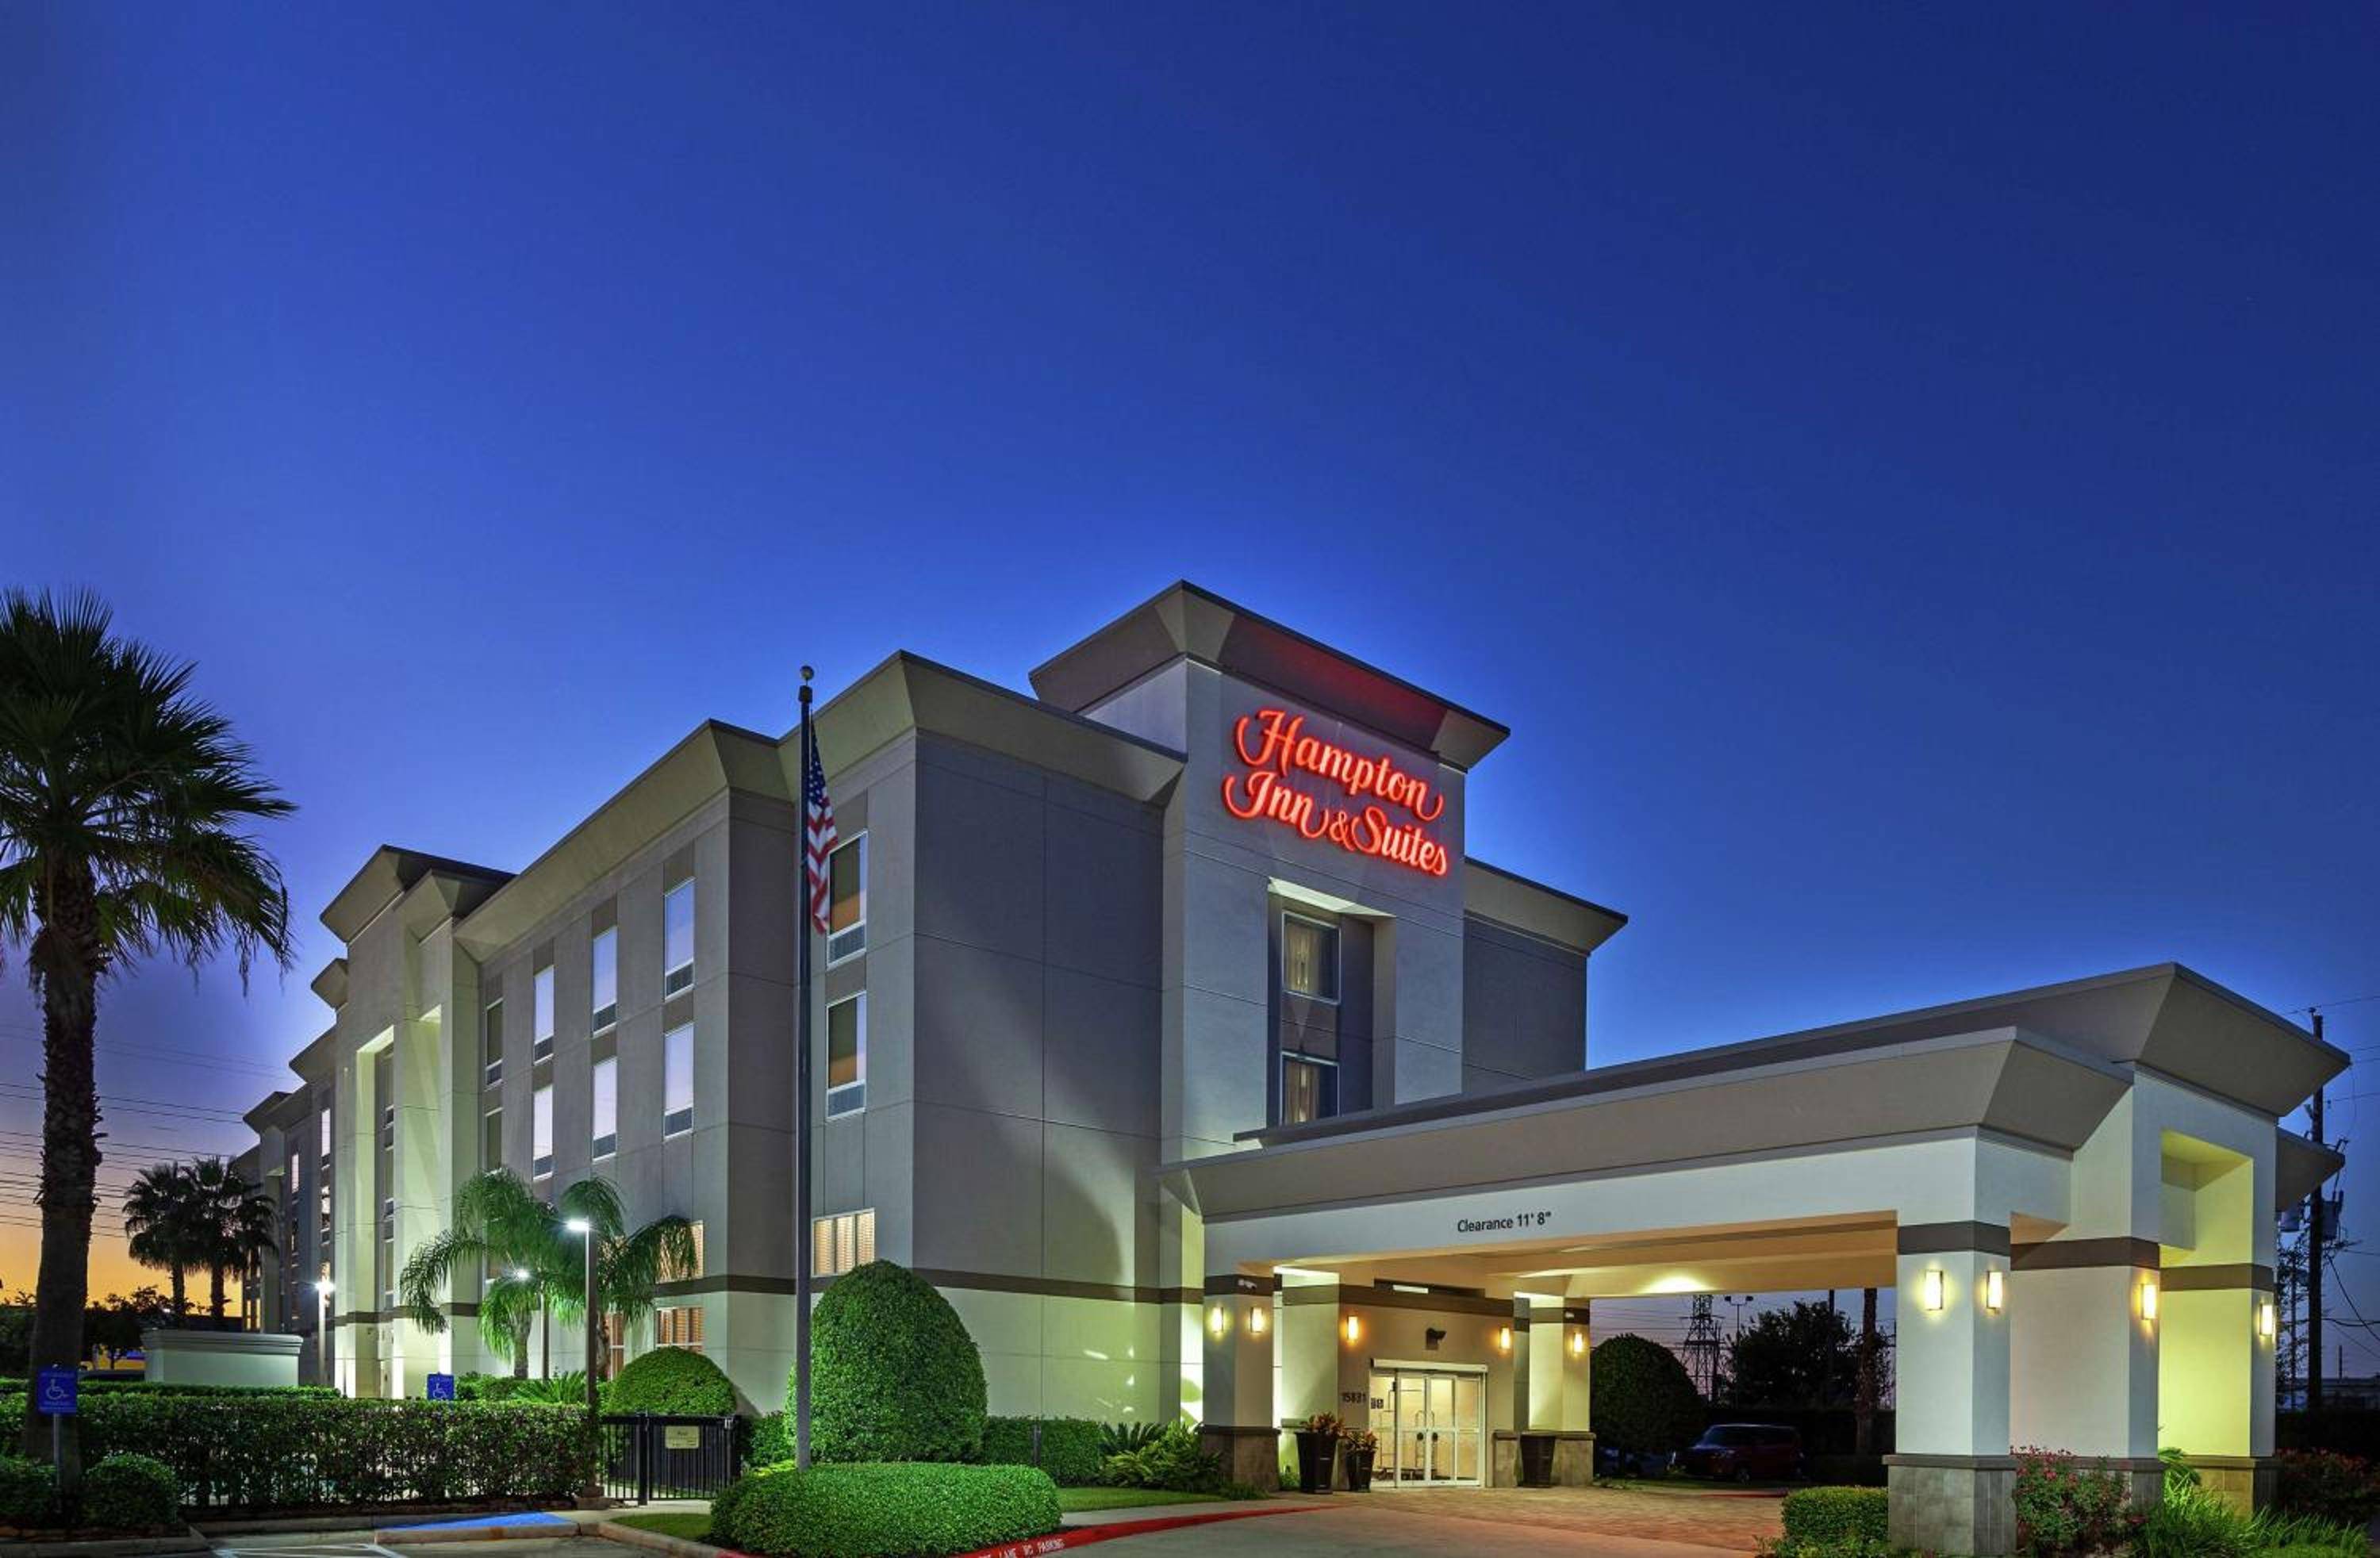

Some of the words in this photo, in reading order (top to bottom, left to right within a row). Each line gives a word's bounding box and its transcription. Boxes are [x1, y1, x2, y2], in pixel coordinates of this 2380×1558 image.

[1234, 709, 1445, 822] Hampton
[1223, 770, 1329, 838] Inn
[1330, 811, 1356, 852] &
[1351, 806, 1448, 877] Suites
[1457, 1218, 1514, 1232] Clearance
